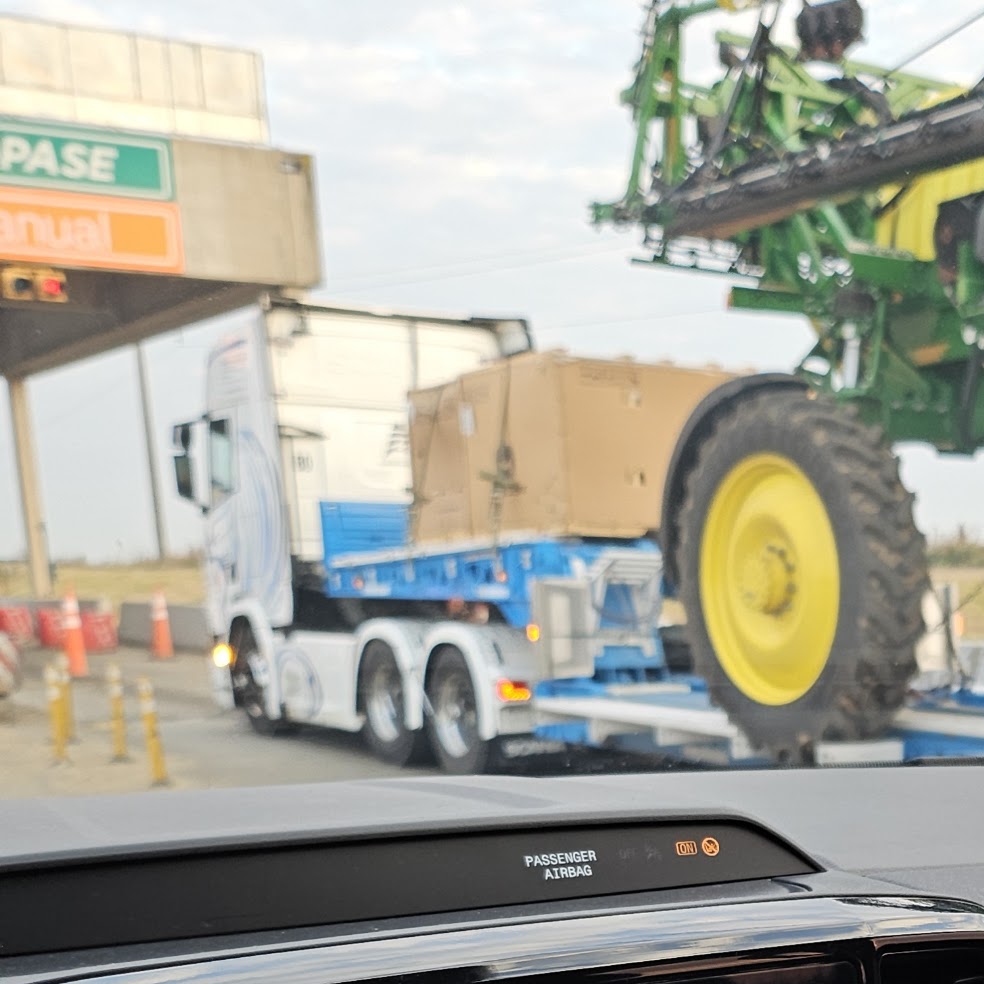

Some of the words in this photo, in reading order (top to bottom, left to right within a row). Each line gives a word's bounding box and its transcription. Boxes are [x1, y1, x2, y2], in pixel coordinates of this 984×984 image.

[0, 136, 119, 183] PASE
[679, 843, 694, 854] ON
[524, 850, 597, 867] PASSENGER
[544, 865, 593, 880] AIRBAG
